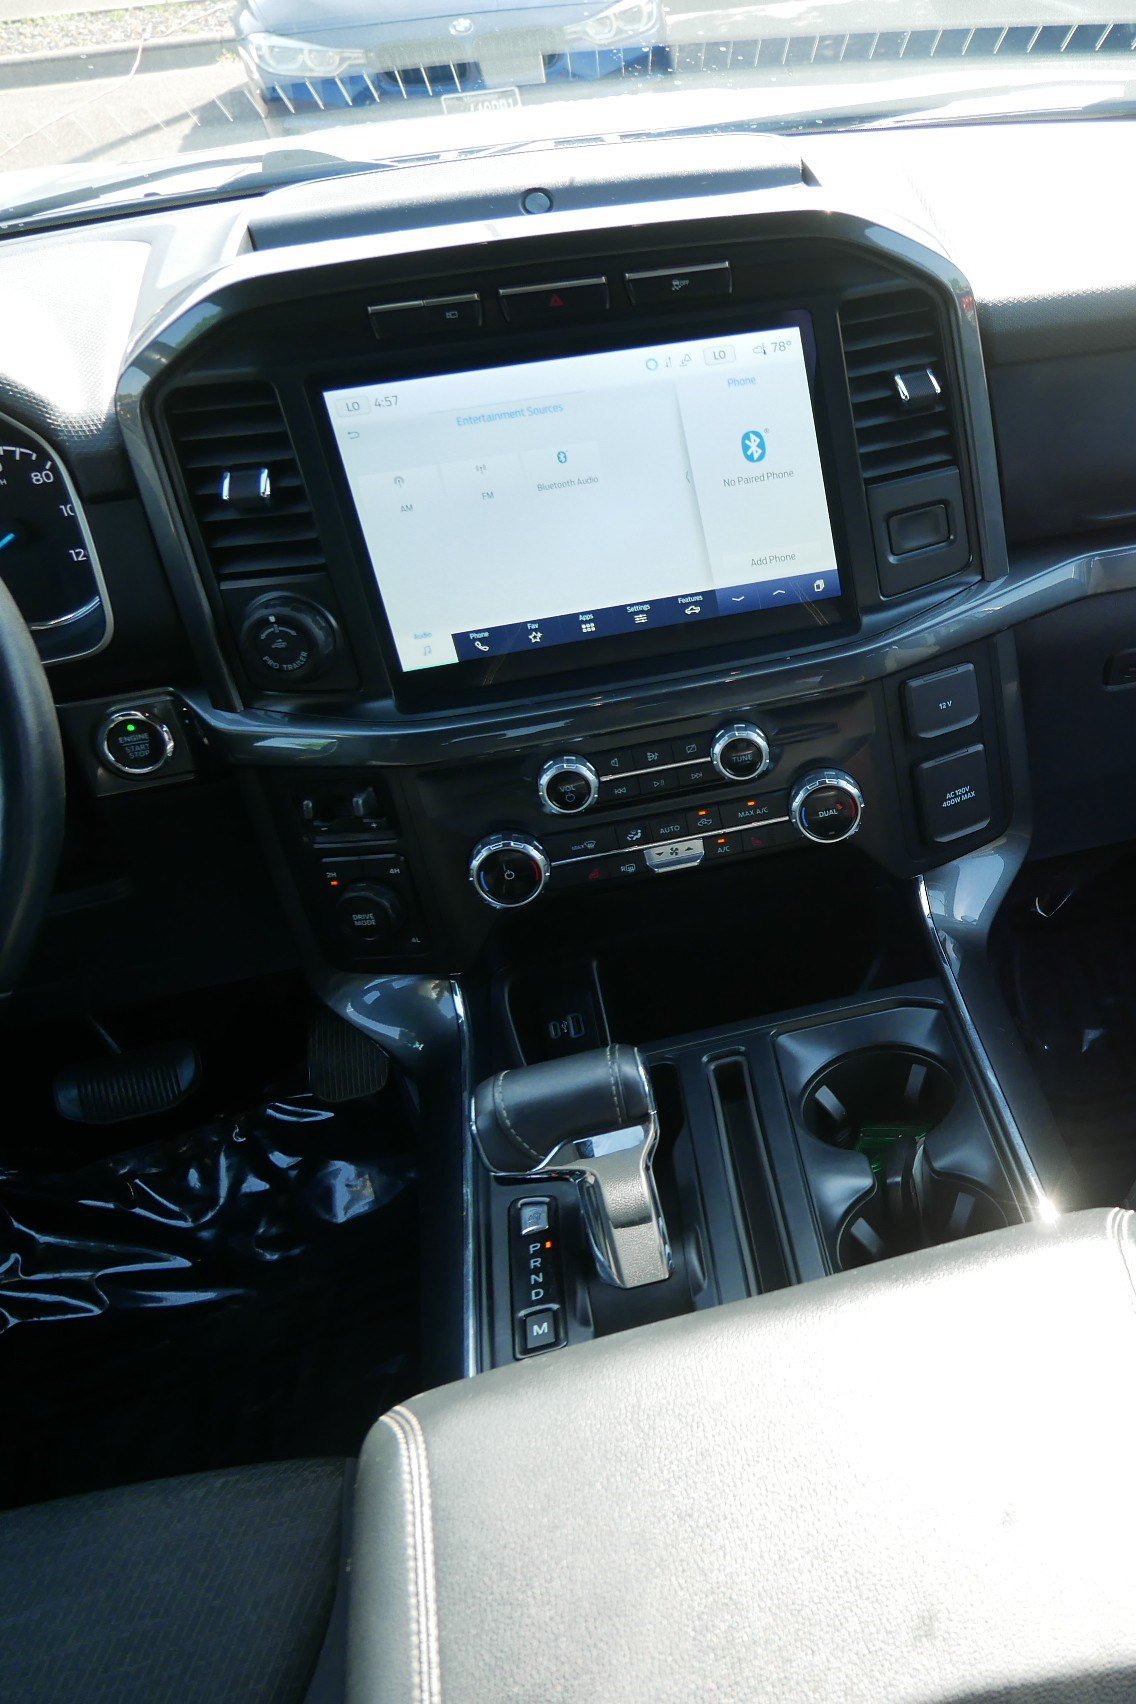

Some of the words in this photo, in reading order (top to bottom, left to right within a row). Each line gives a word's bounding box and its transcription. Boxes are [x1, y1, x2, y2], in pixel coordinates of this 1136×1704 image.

[712, 351, 727, 361] LO
[727, 375, 756, 389] Phone
[345, 401, 360, 412] LO
[374, 395, 399, 409] 4:57
[456, 407, 526, 427] Entertainment
[527, 402, 564, 418] Sources
[31, 470, 54, 485] 80
[536, 477, 576, 492] Bluetooth
[577, 474, 599, 486] Audio
[723, 477, 736, 488] No
[738, 473, 765, 486] Paired
[766, 468, 794, 481] Phone
[482, 491, 495, 501] FM
[400, 504, 414, 514] AM
[68, 549, 87, 561] 12
[750, 556, 768, 567] Add
[769, 552, 796, 565] Phone
[677, 594, 704, 605] Features
[626, 603, 651, 614] Settings
[578, 613, 594, 623] Apps
[527, 622, 539, 631] Fav
[413, 631, 433, 641] Audio
[469, 630, 490, 640] Phone
[262, 655, 281, 669] PRO
[282, 651, 309, 671] TRAILER
[939, 702, 947, 710] 12
[118, 732, 150, 744] ENGINE
[125, 743, 150, 753] START
[128, 750, 150, 760] STOP
[731, 754, 753, 763] TUNE
[559, 784, 577, 793] VOL
[946, 791, 955, 800] AC
[955, 785, 970, 796] 120V
[942, 796, 961, 808] 400W
[961, 790, 976, 802] MAX
[738, 809, 755, 819] MAX
[756, 806, 769, 816] A/C
[818, 808, 838, 818] DUAL
[660, 825, 680, 834] AUTO
[717, 845, 731, 853] A/C
[352, 913, 375, 921] DRIVE
[529, 1243, 541, 1254] P
[530, 1257, 542, 1269] R
[530, 1272, 543, 1285] N
[531, 1288, 544, 1301] D
[532, 1322, 548, 1336] M
